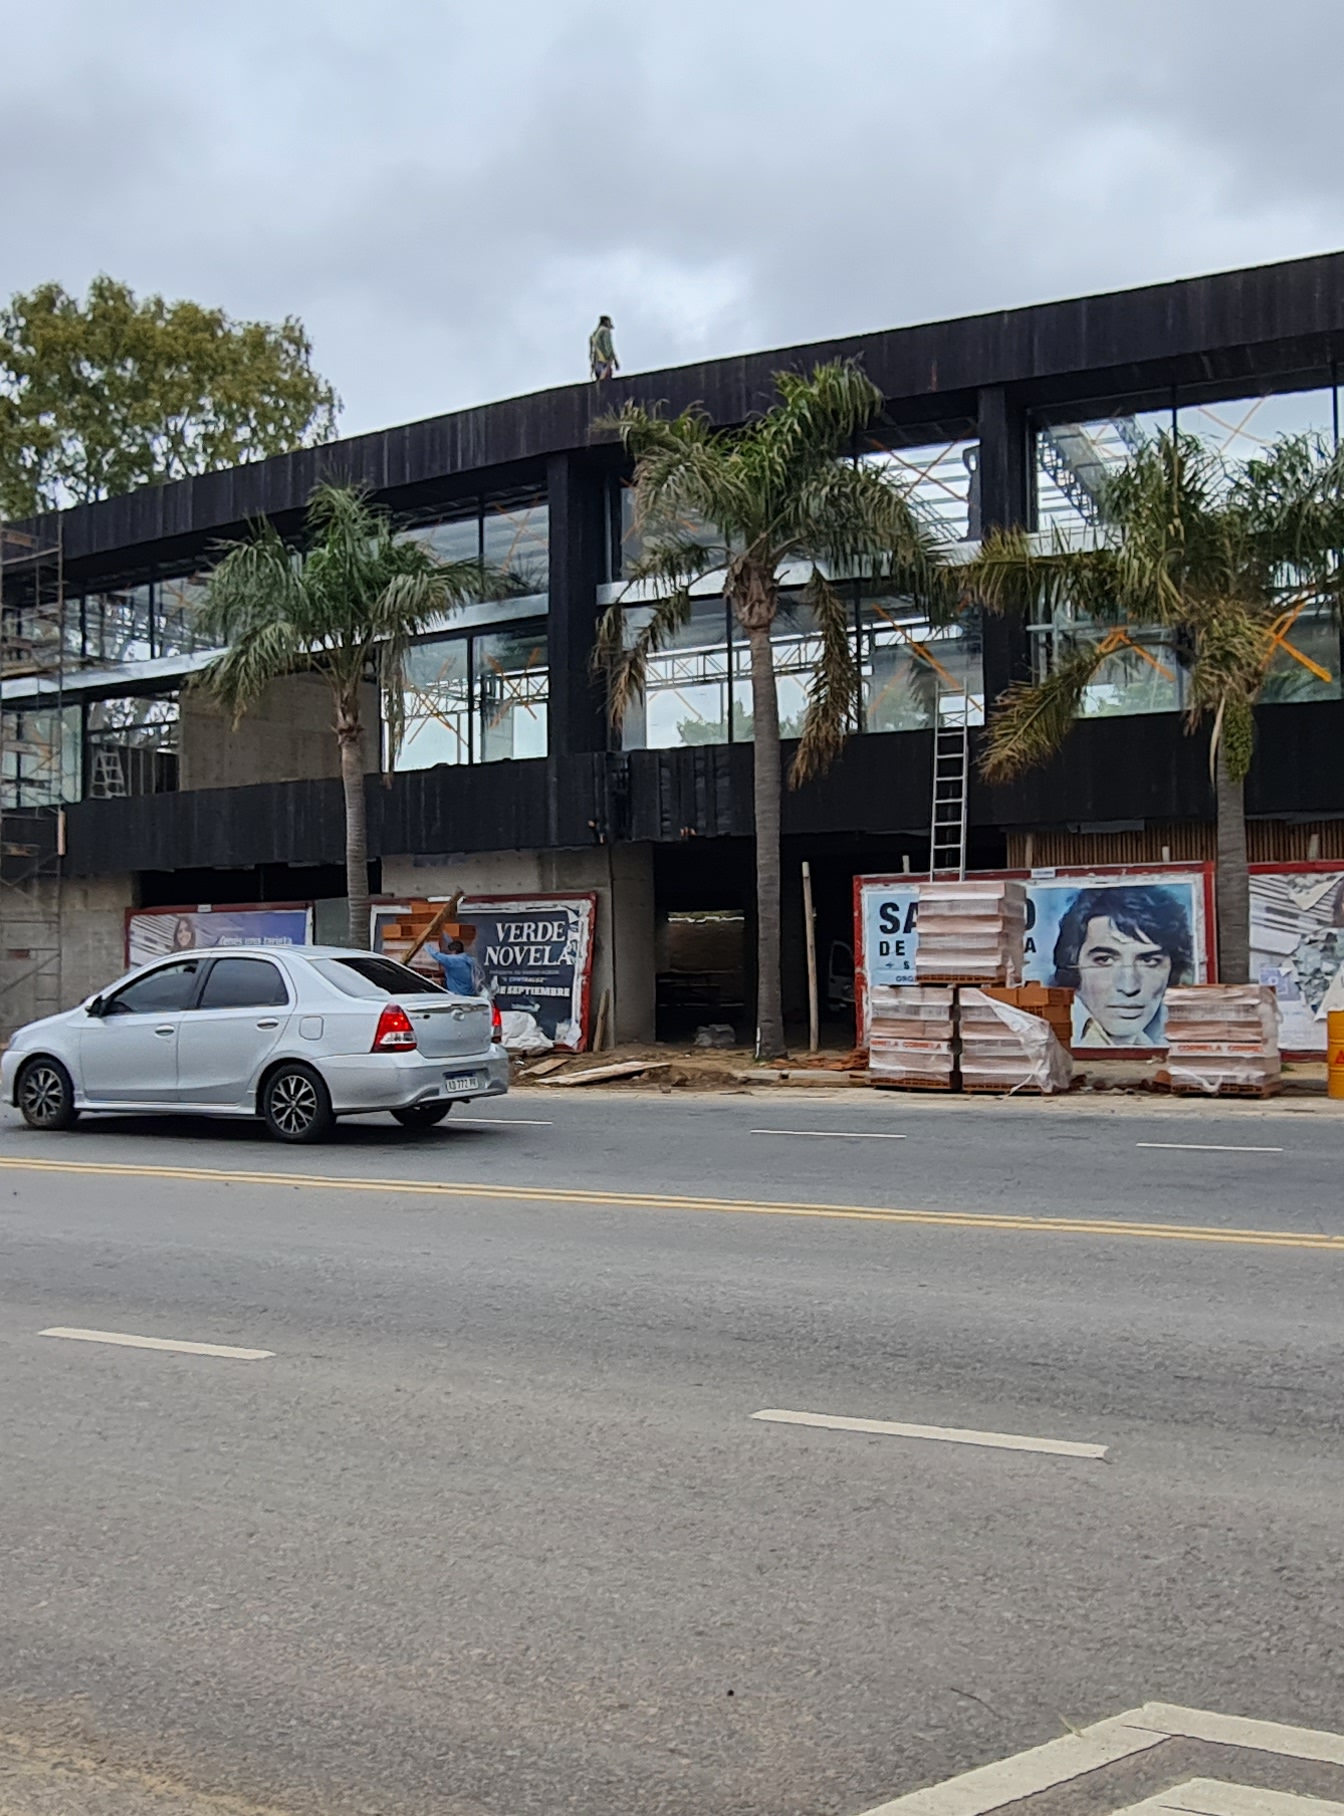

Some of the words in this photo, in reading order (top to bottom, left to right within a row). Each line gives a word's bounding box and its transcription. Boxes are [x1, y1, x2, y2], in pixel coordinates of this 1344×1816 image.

[496, 921, 566, 942] VERDE
[484, 945, 573, 966] NOVELA
[879, 940, 905, 957] DE
[507, 986, 570, 997] SEPTIEMBRE
